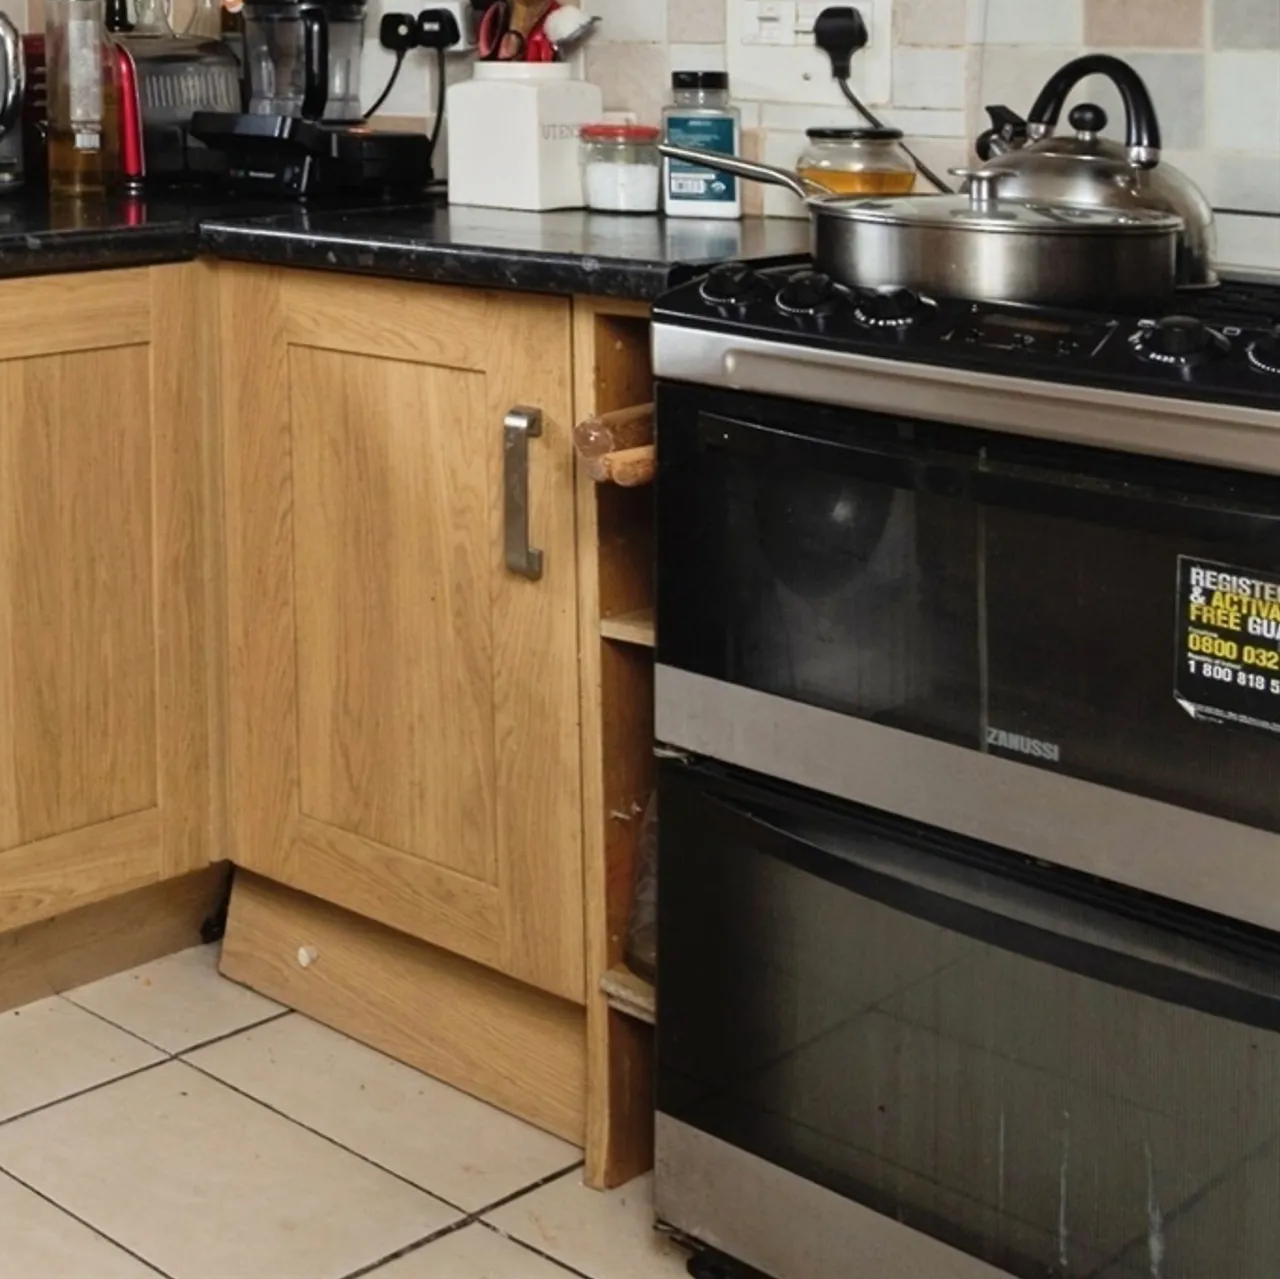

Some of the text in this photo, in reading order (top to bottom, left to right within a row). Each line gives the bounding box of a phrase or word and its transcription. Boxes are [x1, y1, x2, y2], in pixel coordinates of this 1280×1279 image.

[1189, 586, 1206, 606] &
[1190, 602, 1242, 632] FREE
[1188, 632, 1238, 660] 0800
[1242, 645, 1280, 671] 032
[1188, 659, 1196, 674] 1
[1202, 662, 1232, 683] 800
[1236, 671, 1266, 691] 818
[986, 726, 1059, 762] ZANUSSI
